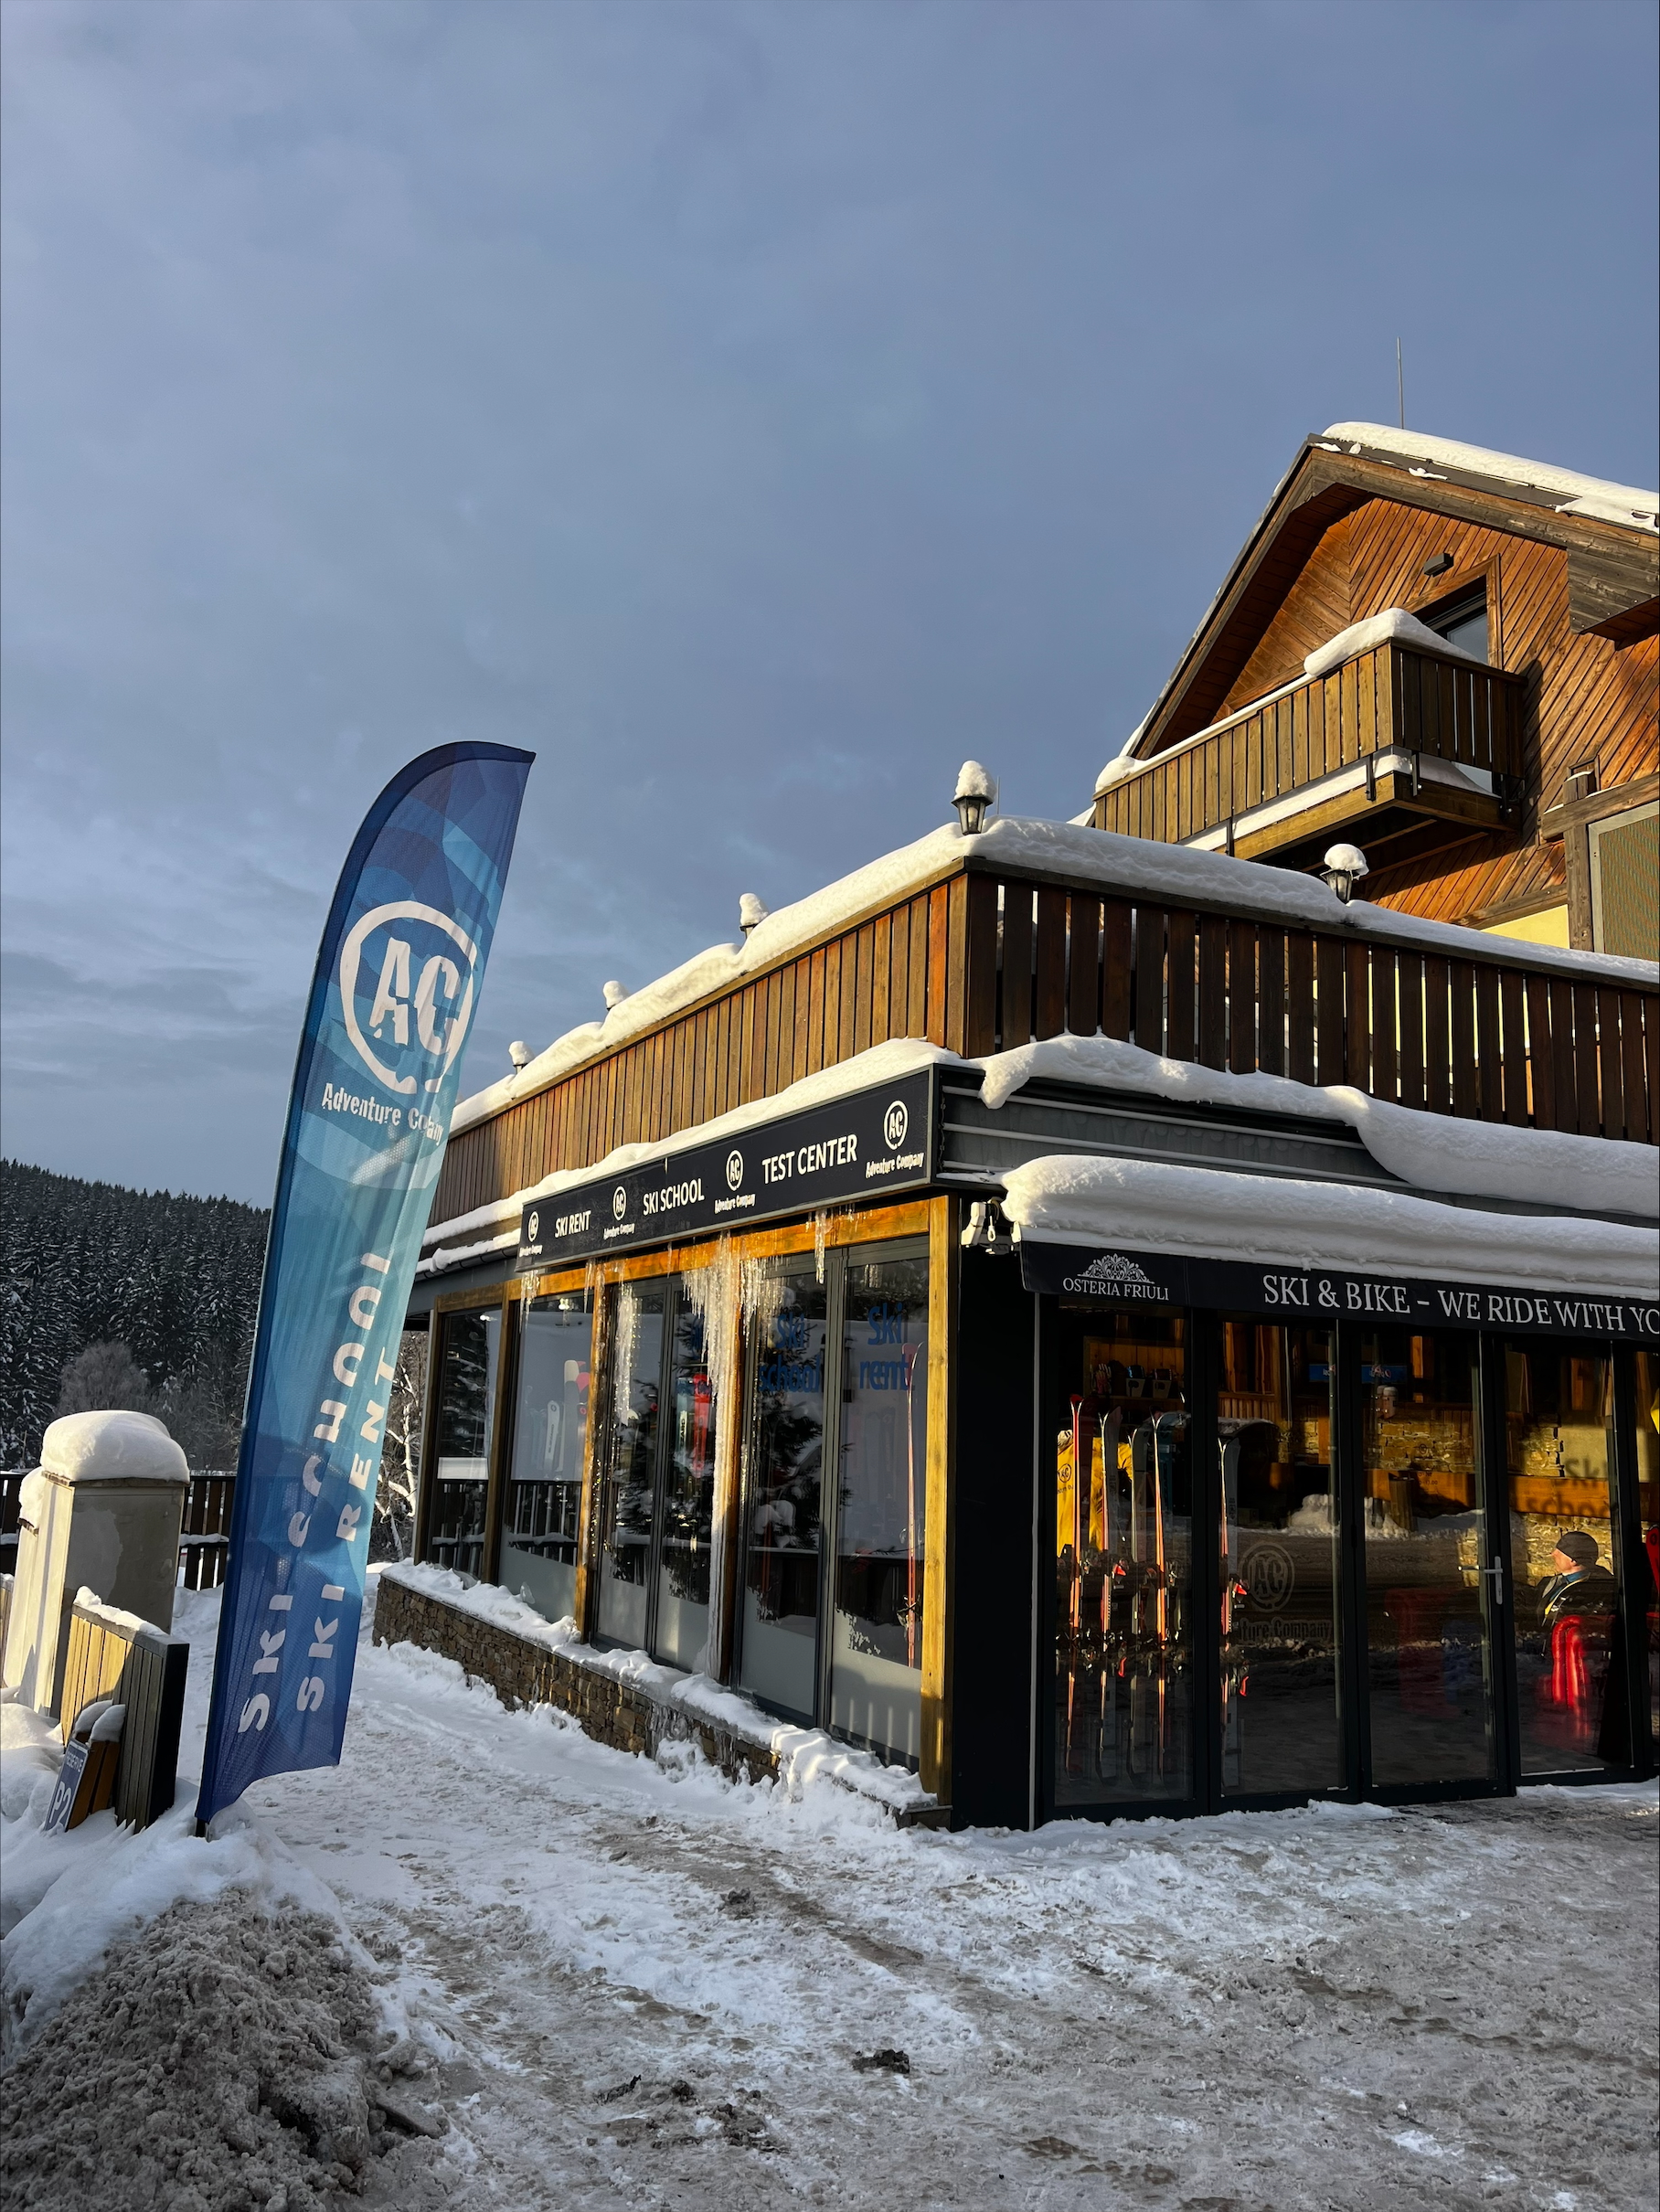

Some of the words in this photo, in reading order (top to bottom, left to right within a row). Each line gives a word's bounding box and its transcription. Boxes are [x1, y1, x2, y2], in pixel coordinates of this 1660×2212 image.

[322, 1082, 402, 1126] Adventure
[889, 1110, 904, 1140] AC
[761, 1150, 795, 1184] TEST
[797, 1133, 858, 1175] CENTER
[865, 1157, 895, 1179] Adventure
[896, 1151, 925, 1171] Company
[643, 1191, 659, 1216] SKI
[660, 1178, 705, 1212] SCHOOL
[554, 1217, 569, 1239] SKI
[569, 1209, 591, 1237] RENT
[1063, 1278, 1120, 1296] OSTERIA
[1123, 1283, 1169, 1301] FRIULI
[1263, 1274, 1310, 1307] SKI
[1318, 1279, 1340, 1309] &
[1346, 1281, 1410, 1314] BIKE
[1437, 1290, 1481, 1320] WE
[1487, 1294, 1552, 1324] RIDE
[1553, 1300, 1625, 1331] WITH
[776, 1312, 806, 1349] Ski
[867, 1302, 903, 1345] Ski
[758, 1350, 821, 1394] school
[859, 1354, 909, 1391] rent
[296, 1583, 345, 1712] SKI
[335, 1346, 395, 1542] RENT
[238, 1594, 293, 1733] SKI
[48, 1781, 71, 1825] P2
